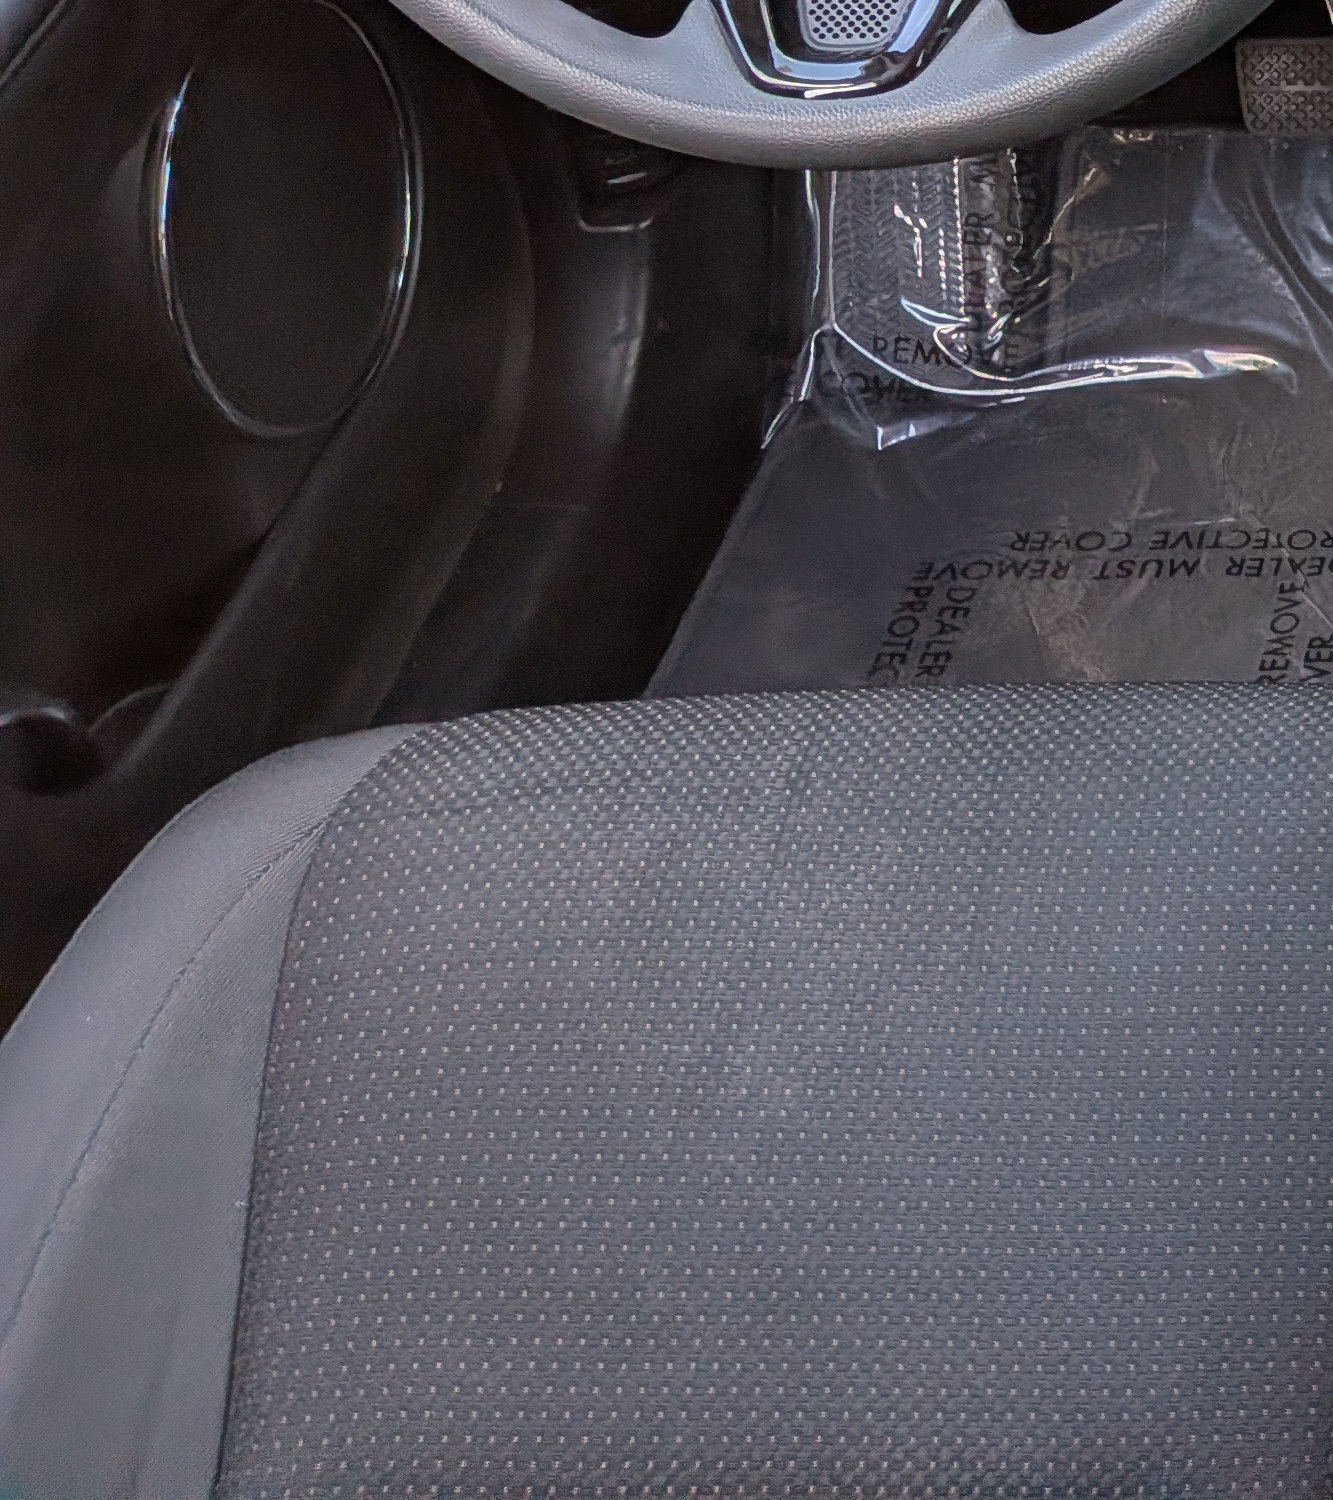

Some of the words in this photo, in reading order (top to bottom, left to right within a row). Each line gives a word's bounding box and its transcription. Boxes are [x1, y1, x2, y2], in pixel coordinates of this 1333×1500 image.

[1009, 530, 1133, 551] COVER
[913, 559, 1070, 582] REMOVE
[1092, 557, 1201, 580] MUST
[917, 583, 978, 678] DEALER
